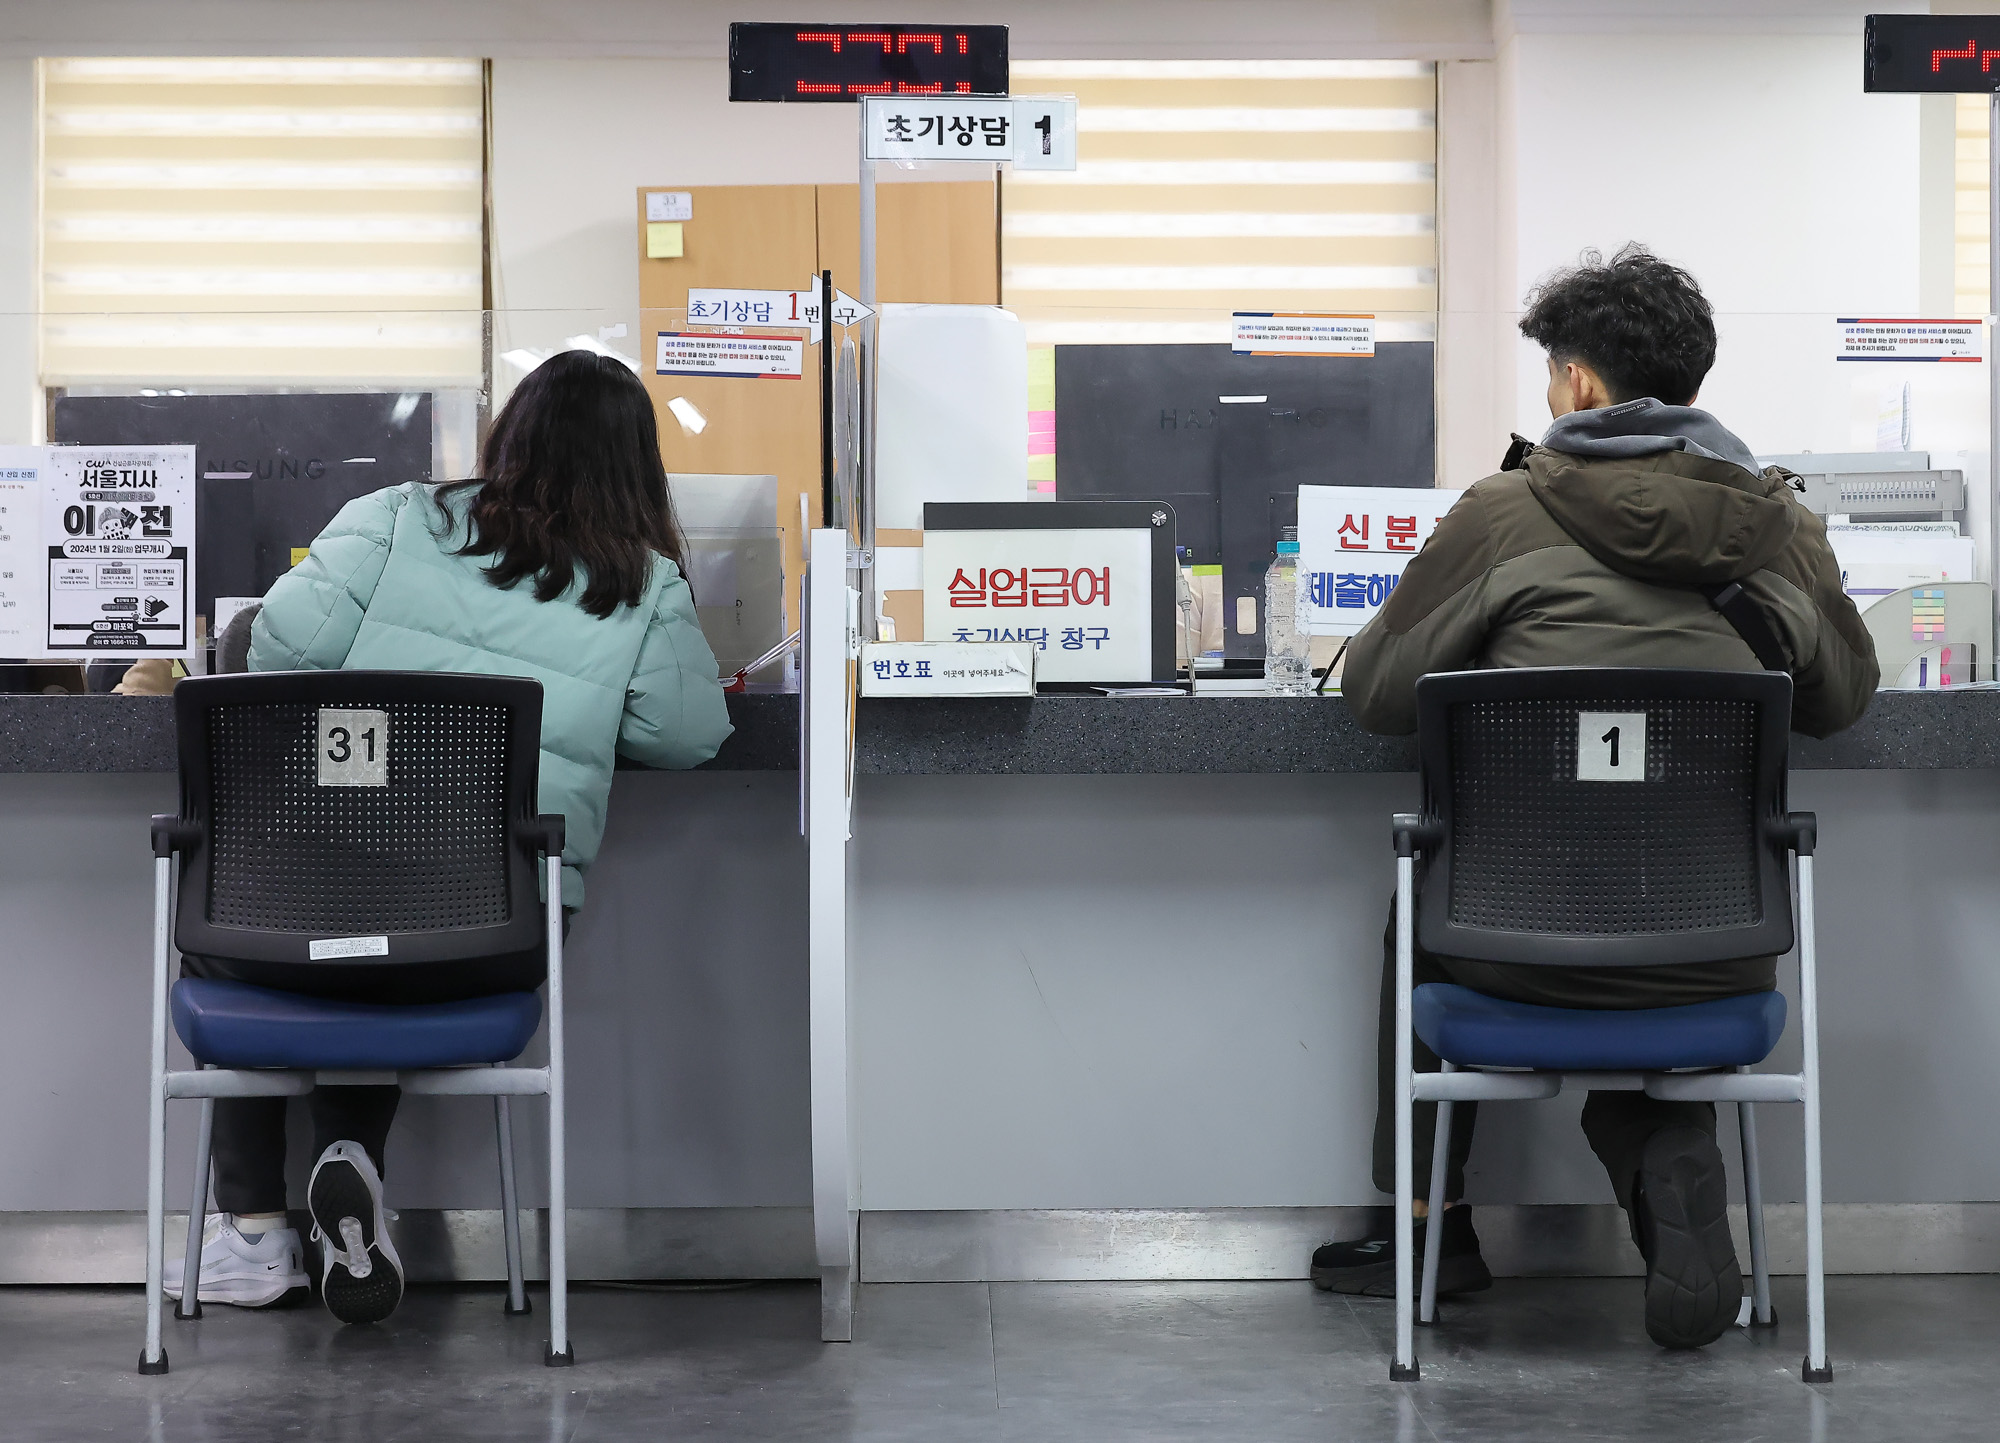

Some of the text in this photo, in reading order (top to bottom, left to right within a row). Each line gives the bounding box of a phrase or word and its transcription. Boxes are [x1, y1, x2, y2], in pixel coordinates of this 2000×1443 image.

[884, 114, 1051, 155] 초기상담 1
[688, 300, 774, 323] 초기상담
[79, 469, 158, 489] 서울지사
[70, 545, 97, 554] 2024년
[98, 545, 110, 554] 1월
[134, 544, 165, 554] 업무개시
[947, 566, 1110, 608] 실업급여
[1060, 627, 1111, 650] 창구
[873, 659, 933, 680] 번호표
[943, 669, 965, 678] 이곳에
[326, 726, 376, 763] 31
[1601, 726, 1621, 767] 1
